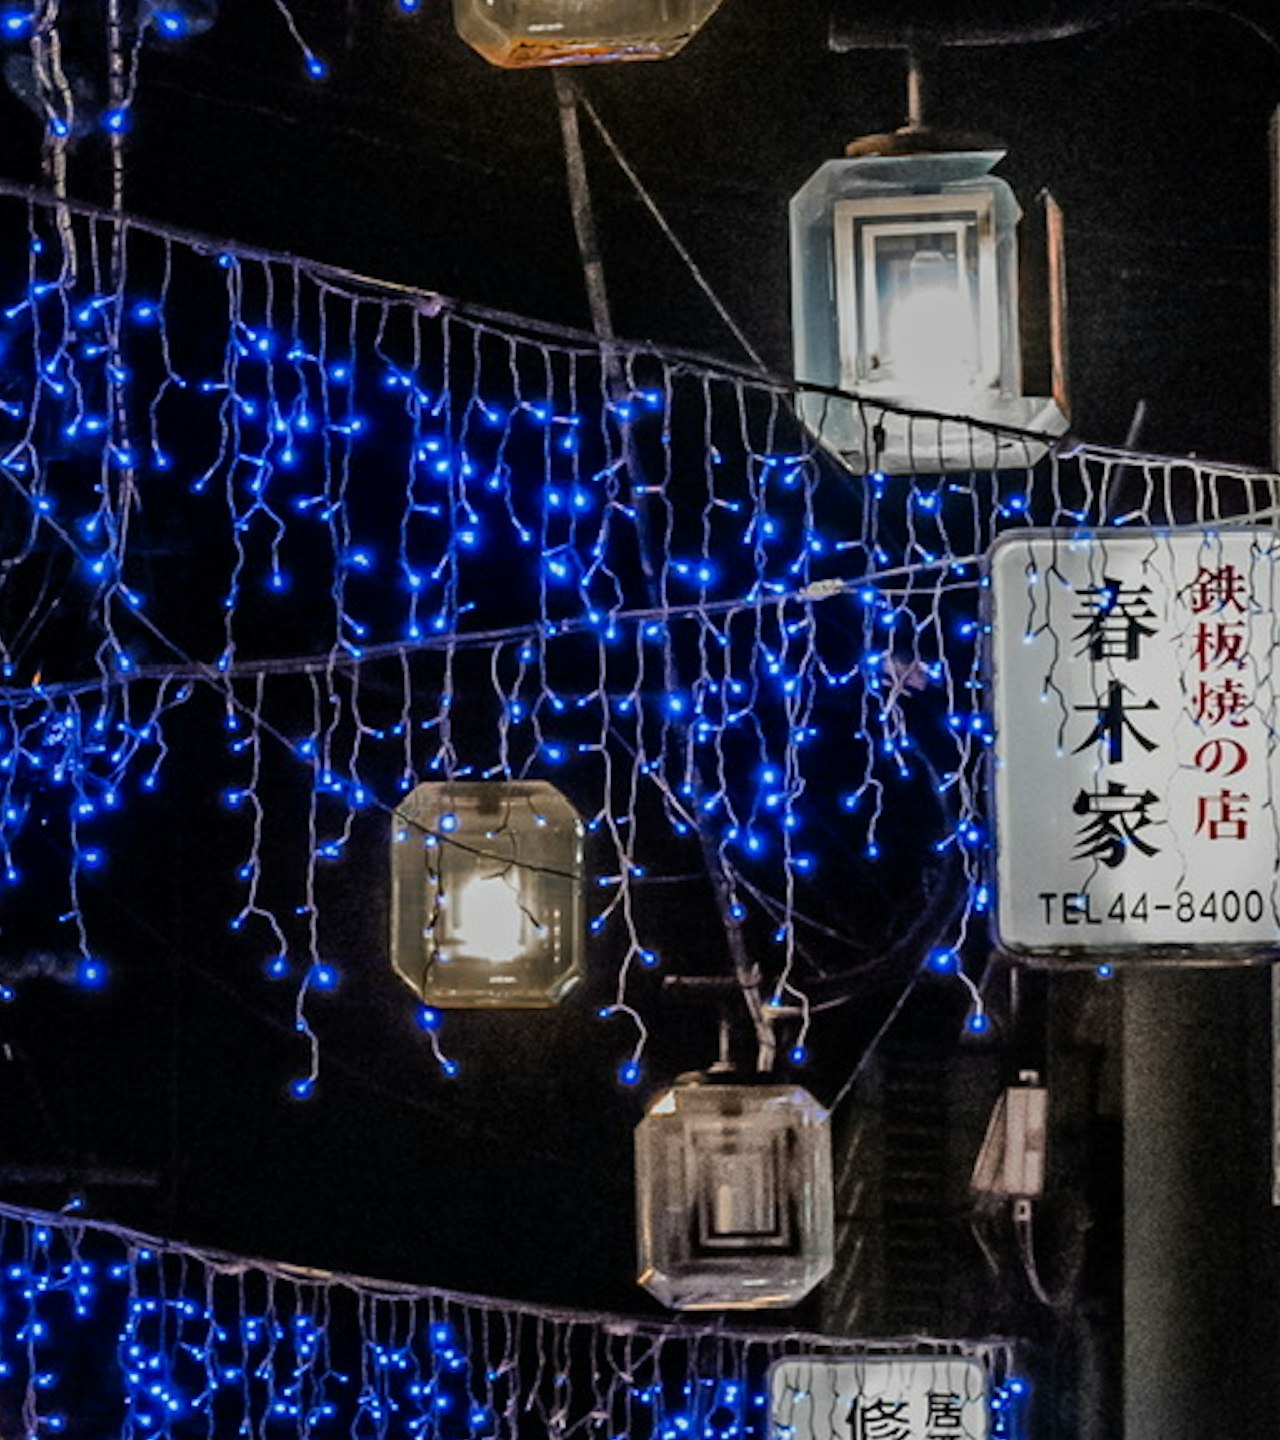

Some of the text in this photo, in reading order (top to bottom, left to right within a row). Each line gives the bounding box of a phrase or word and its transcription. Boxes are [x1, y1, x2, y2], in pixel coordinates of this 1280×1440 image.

[1069, 575, 1163, 871] 春木家
[1190, 563, 1251, 842] 鉄板焼の店
